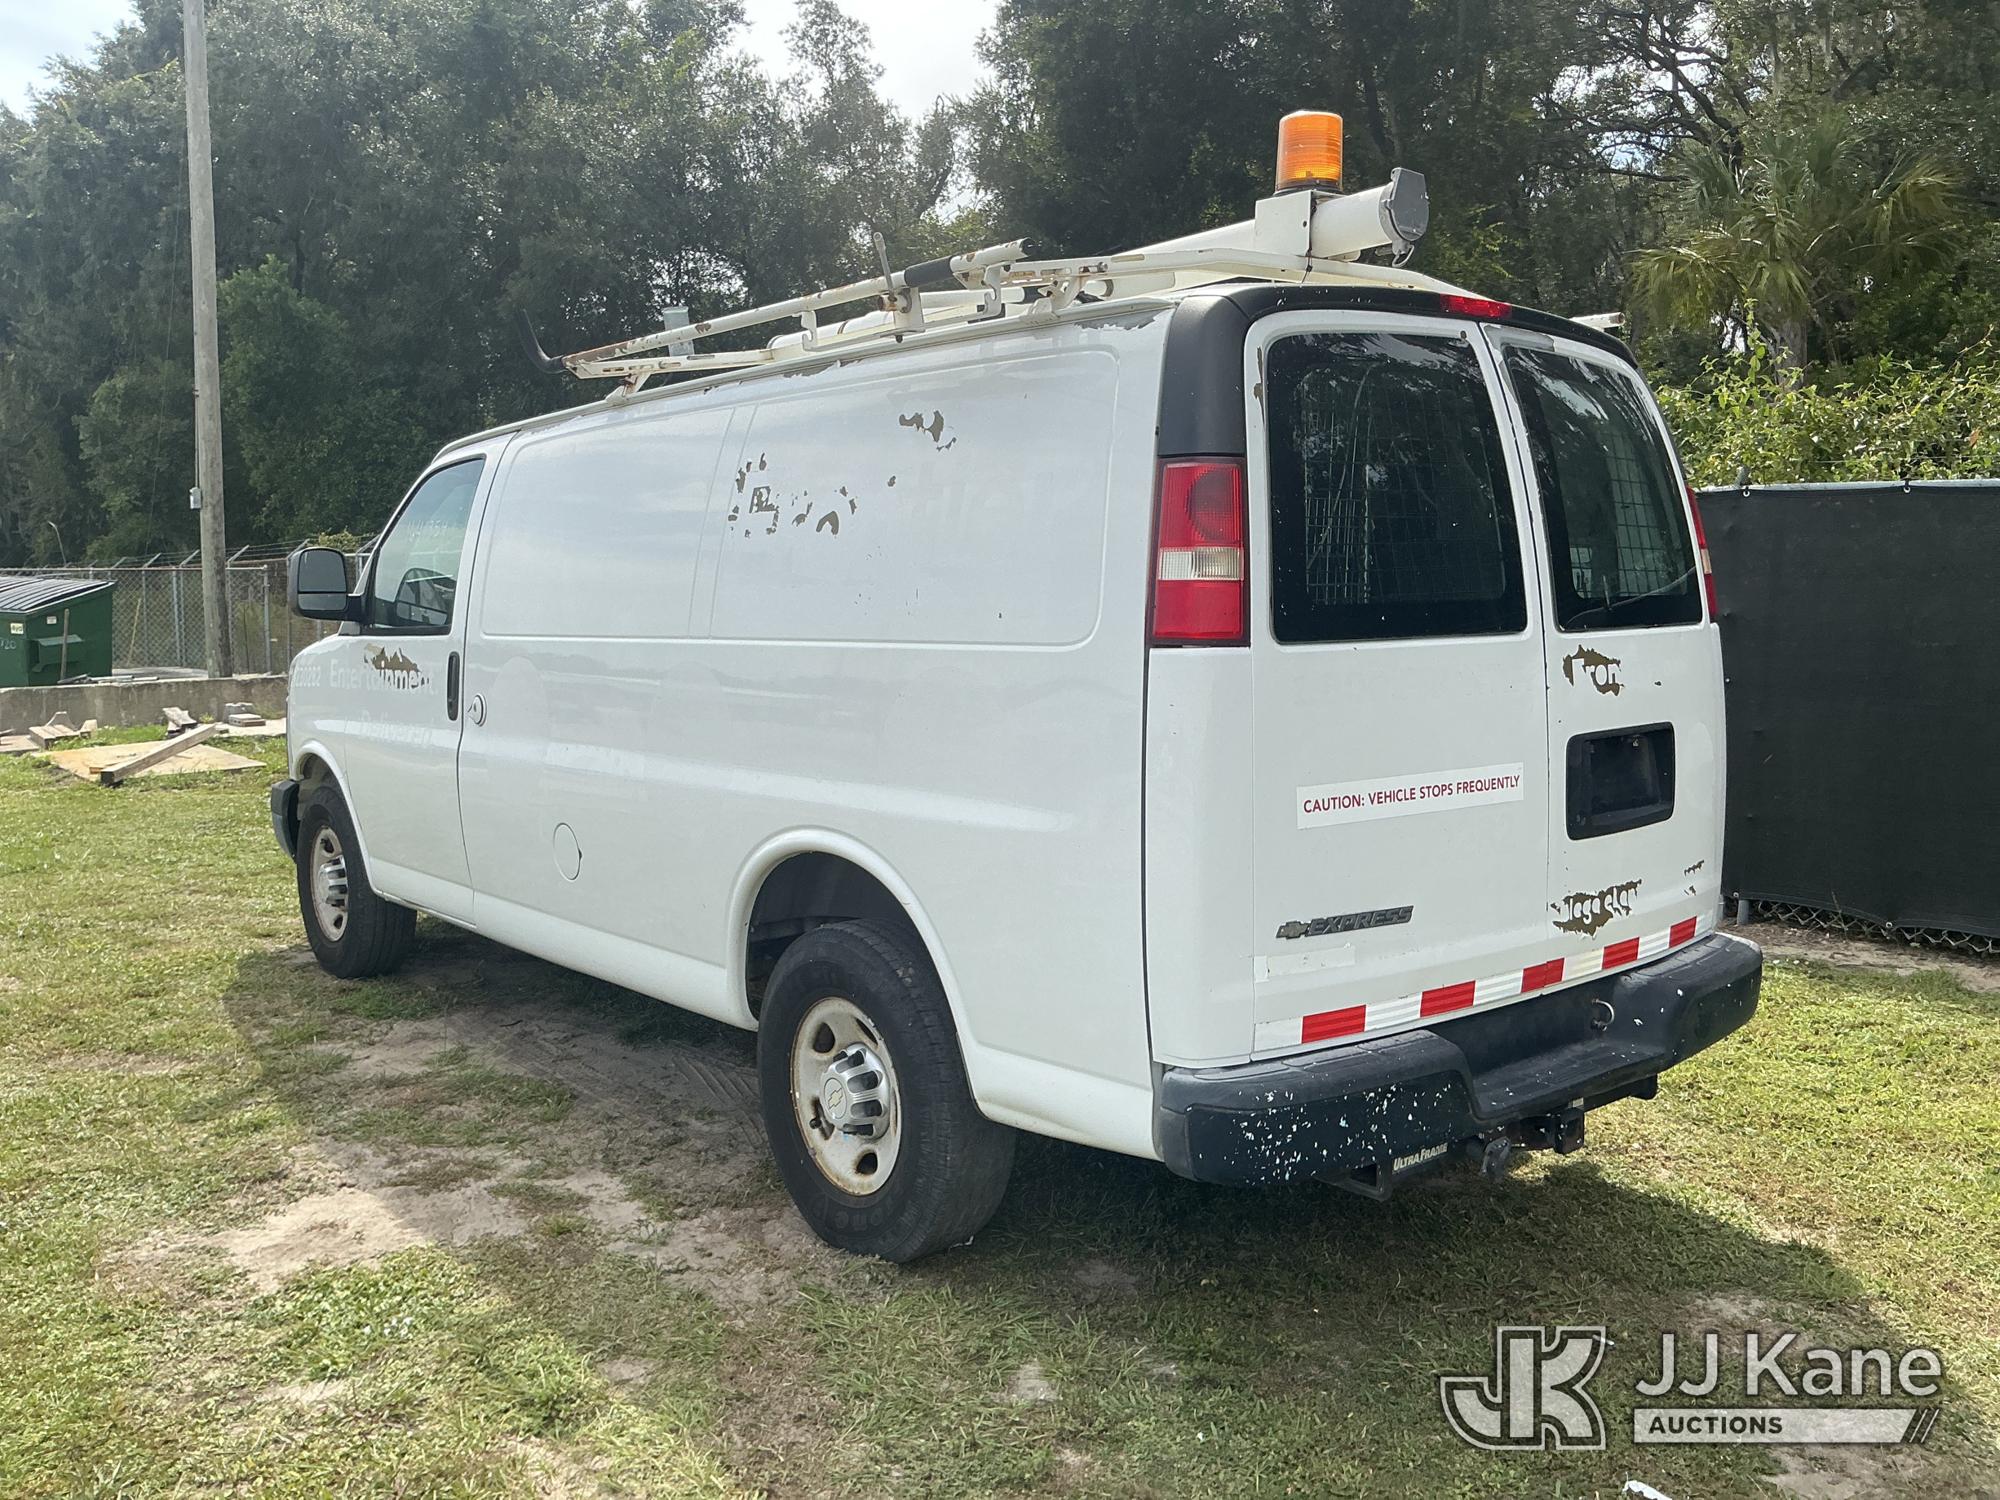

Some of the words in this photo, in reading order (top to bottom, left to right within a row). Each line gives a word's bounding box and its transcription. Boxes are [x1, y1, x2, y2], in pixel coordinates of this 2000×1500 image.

[1303, 794, 1365, 814] CAUTION:
[1368, 787, 1416, 806] VEHICLE
[1420, 782, 1453, 800] STOPS
[1456, 775, 1520, 795] FREQUENTLY
[1306, 907, 1412, 936] EXPRESS
